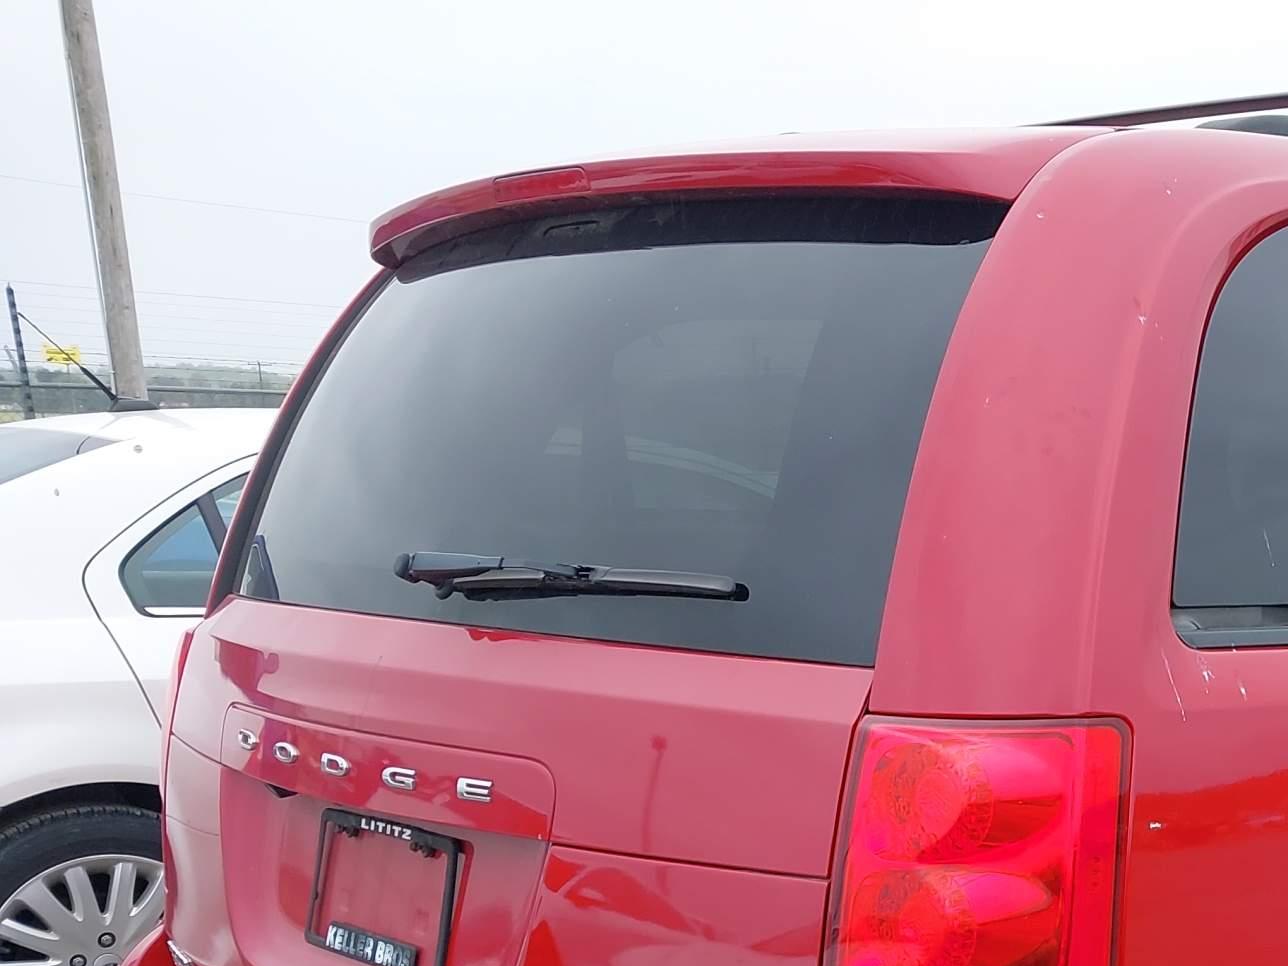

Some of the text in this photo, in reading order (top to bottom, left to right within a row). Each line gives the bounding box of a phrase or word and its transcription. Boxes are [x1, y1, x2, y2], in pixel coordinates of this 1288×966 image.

[238, 728, 494, 802] DODGE
[360, 818, 412, 840] LITITZ
[325, 924, 373, 960] KELLER
